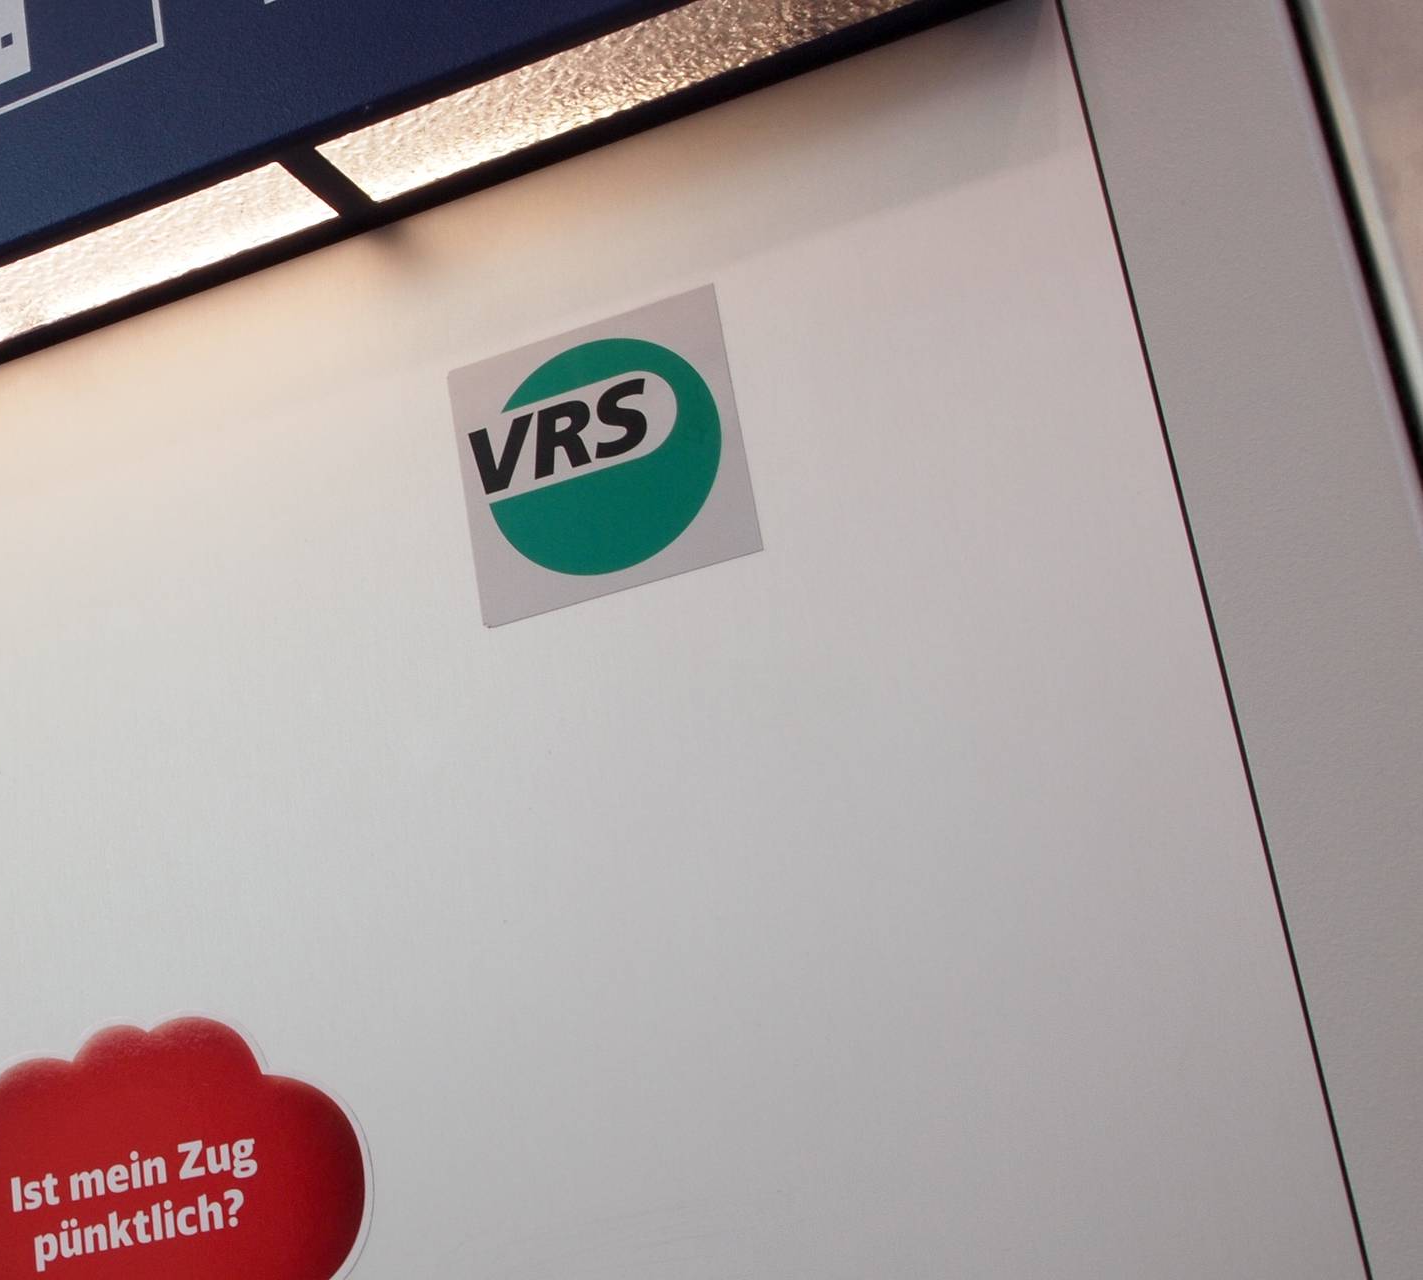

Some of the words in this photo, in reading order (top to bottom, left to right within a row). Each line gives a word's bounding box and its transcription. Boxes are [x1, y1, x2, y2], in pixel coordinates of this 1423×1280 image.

[468, 378, 648, 495] VRS
[10, 1173, 60, 1213] Ist
[70, 1151, 168, 1200] mein
[177, 1137, 258, 1178] Zug
[33, 1189, 245, 1272] pünktlich?
